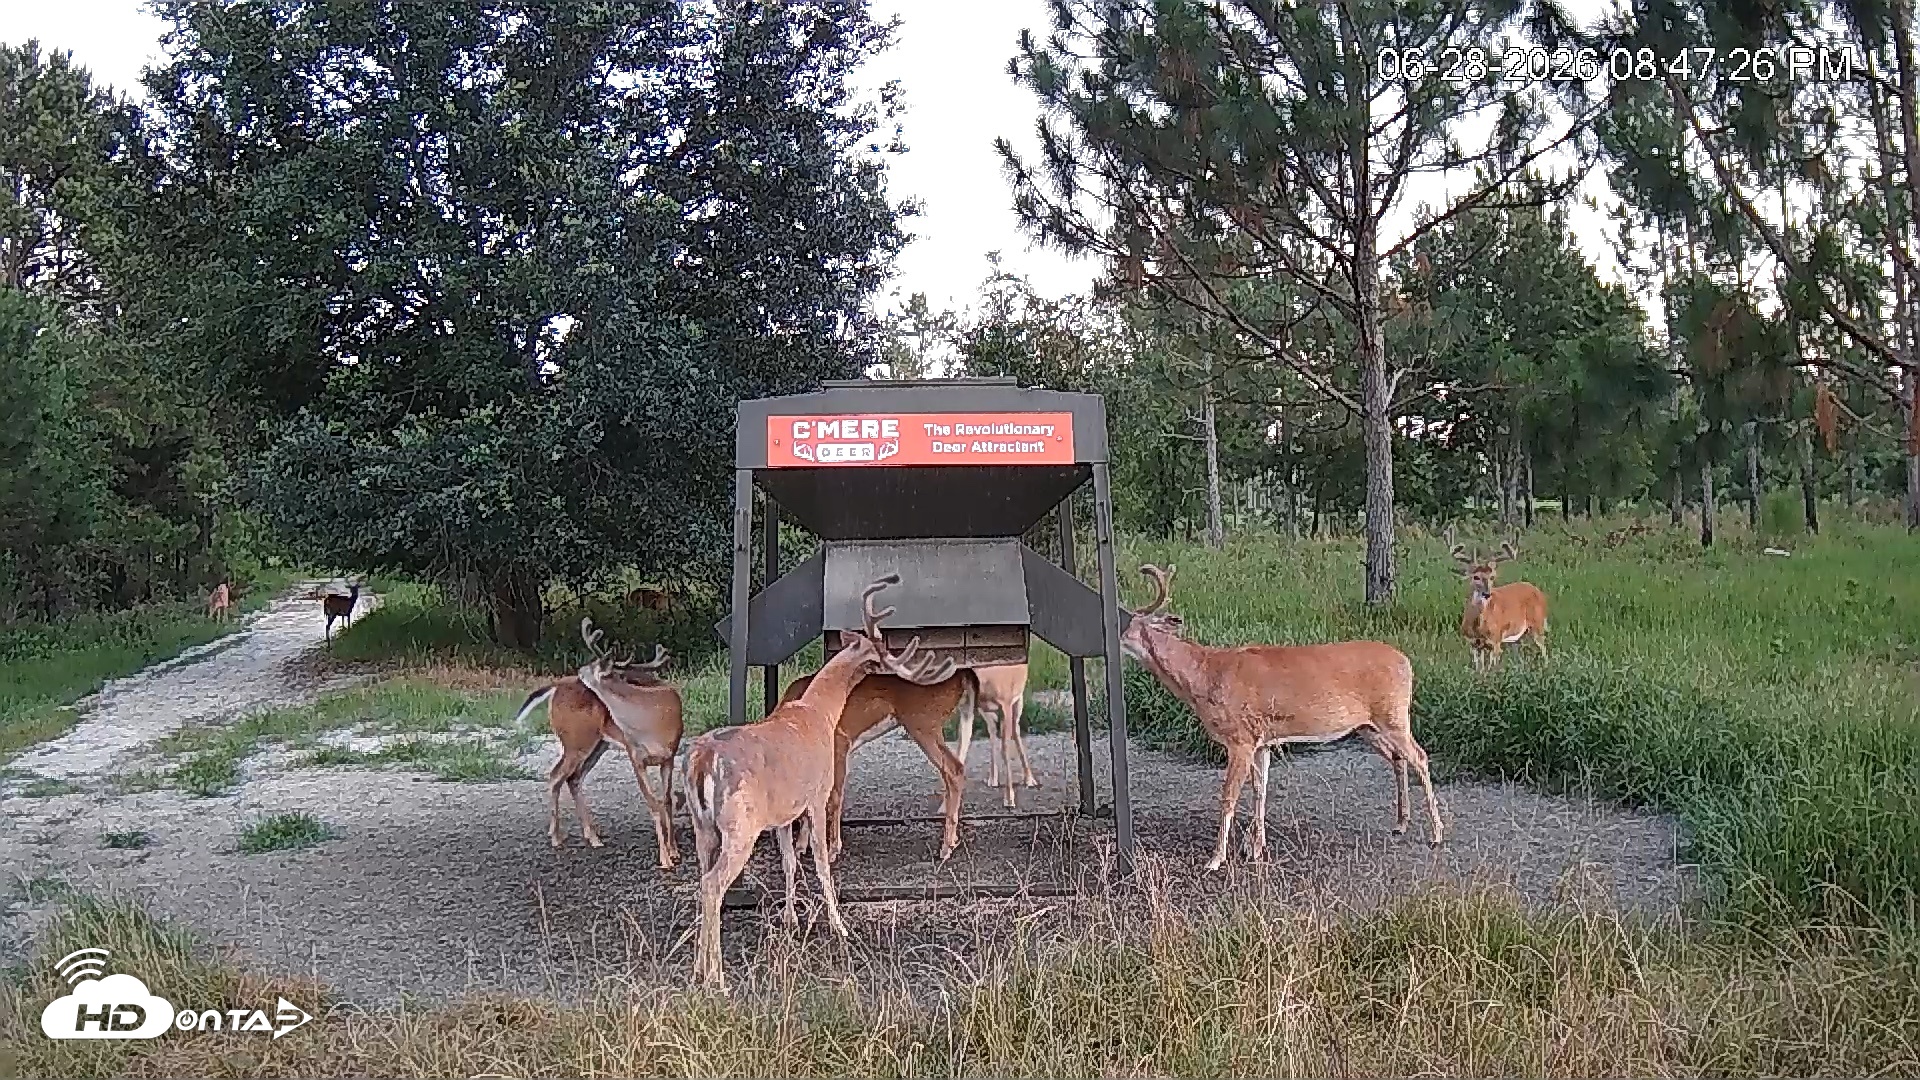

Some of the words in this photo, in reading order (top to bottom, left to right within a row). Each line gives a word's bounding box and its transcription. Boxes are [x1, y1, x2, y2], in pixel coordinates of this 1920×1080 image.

[793, 419, 900, 439] C'MERE
[923, 423, 951, 436] The
[955, 422, 1055, 437] Revolutionary
[820, 446, 872, 458] DEER
[932, 441, 967, 453] Deer
[971, 440, 1046, 453] Attractant
